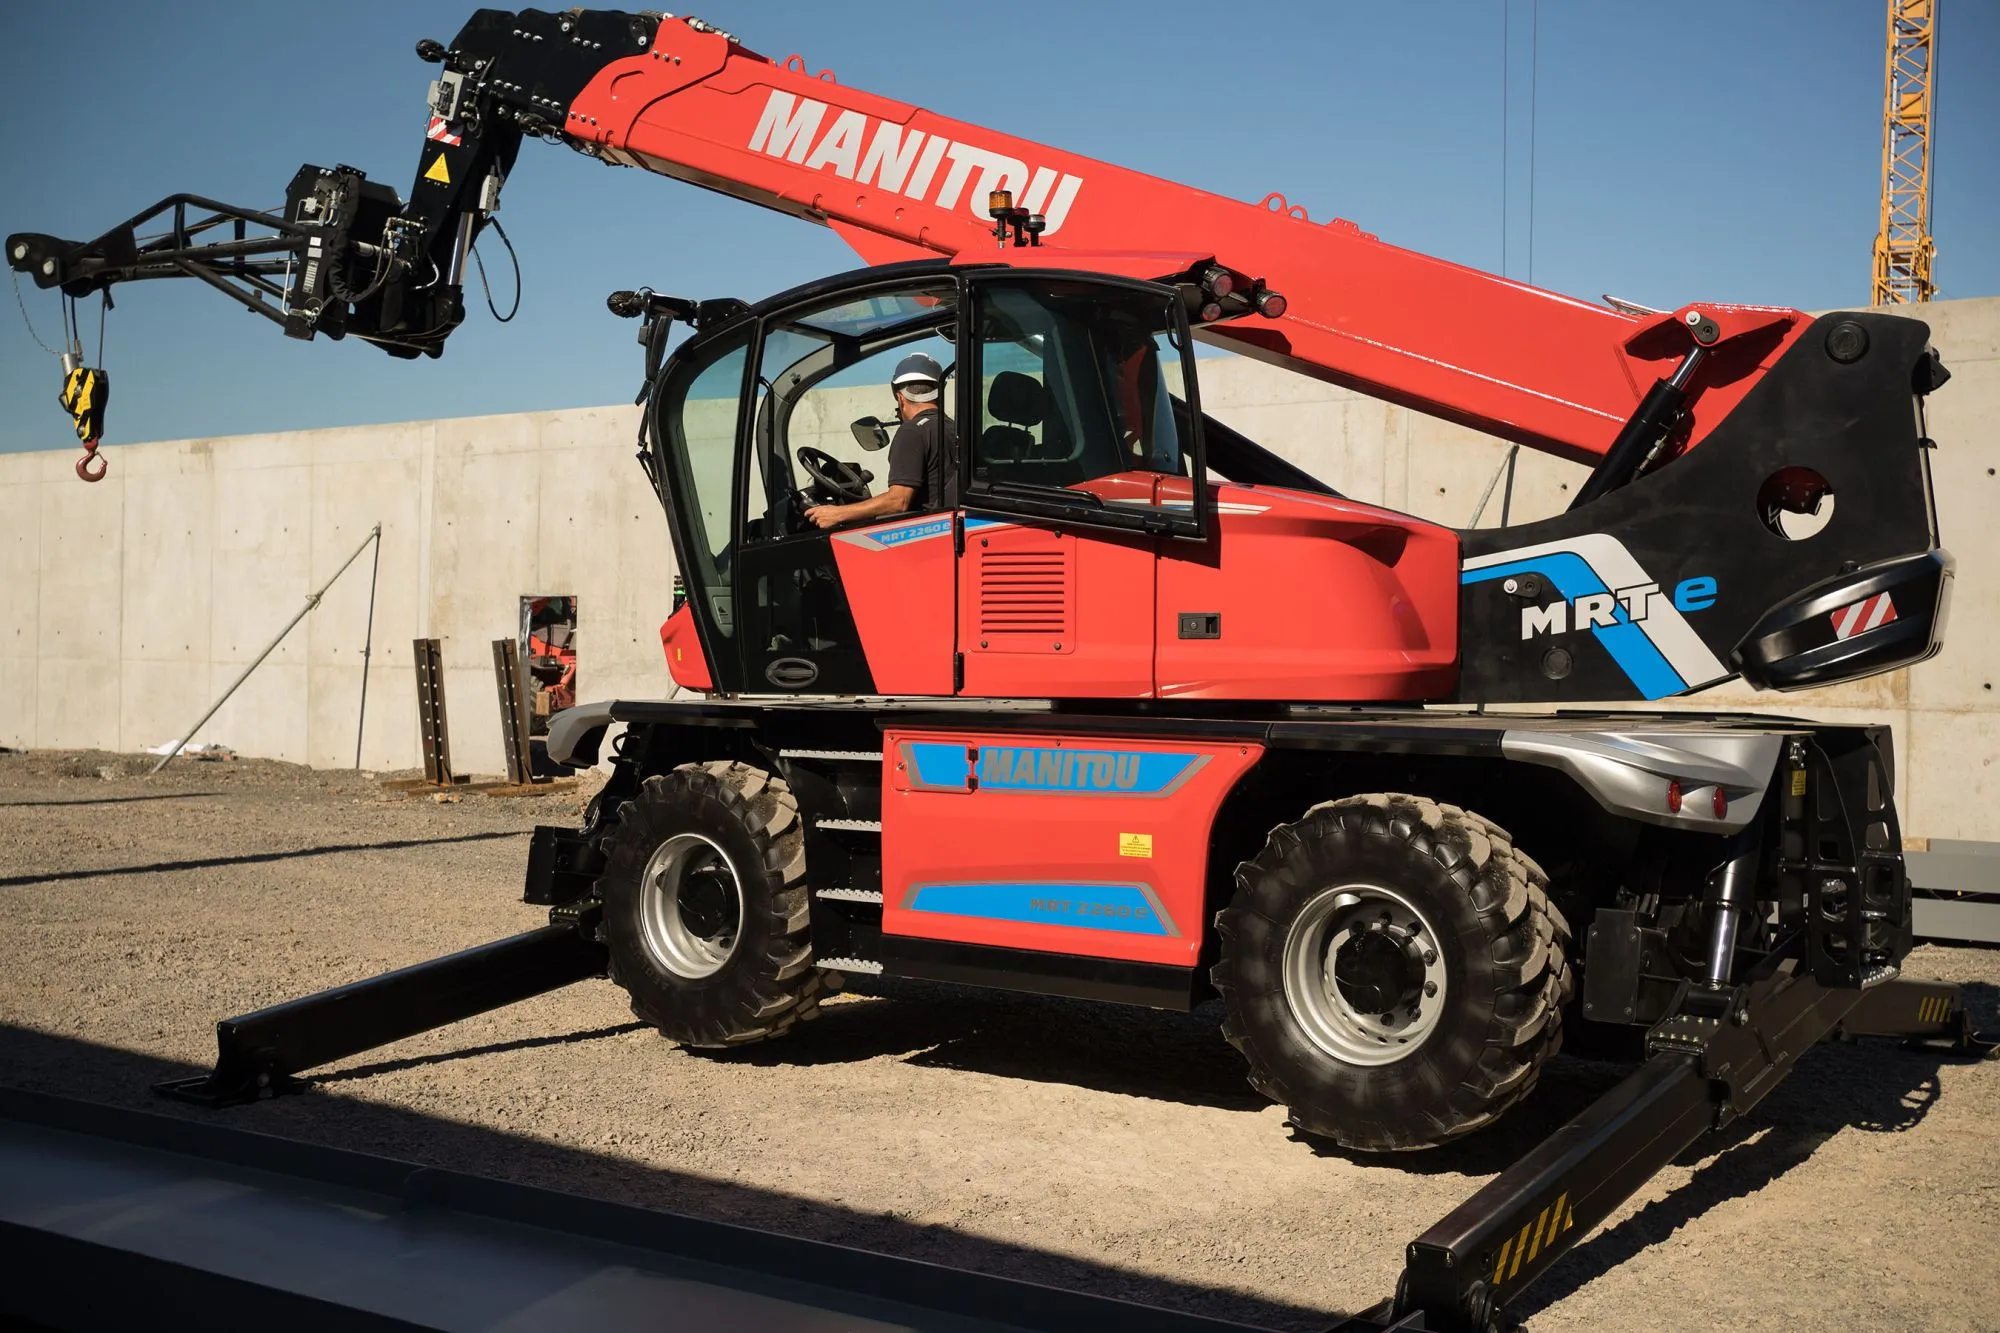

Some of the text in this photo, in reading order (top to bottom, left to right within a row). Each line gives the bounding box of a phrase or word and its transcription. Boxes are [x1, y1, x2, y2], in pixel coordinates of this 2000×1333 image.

[748, 89, 1083, 236] MANITOU
[881, 531, 906, 543] MRT
[908, 525, 941, 537] 2260
[1522, 576, 1717, 640] MRT e
[982, 750, 1140, 788] MANITOU
[1030, 898, 1149, 919] MRT 2260 e
